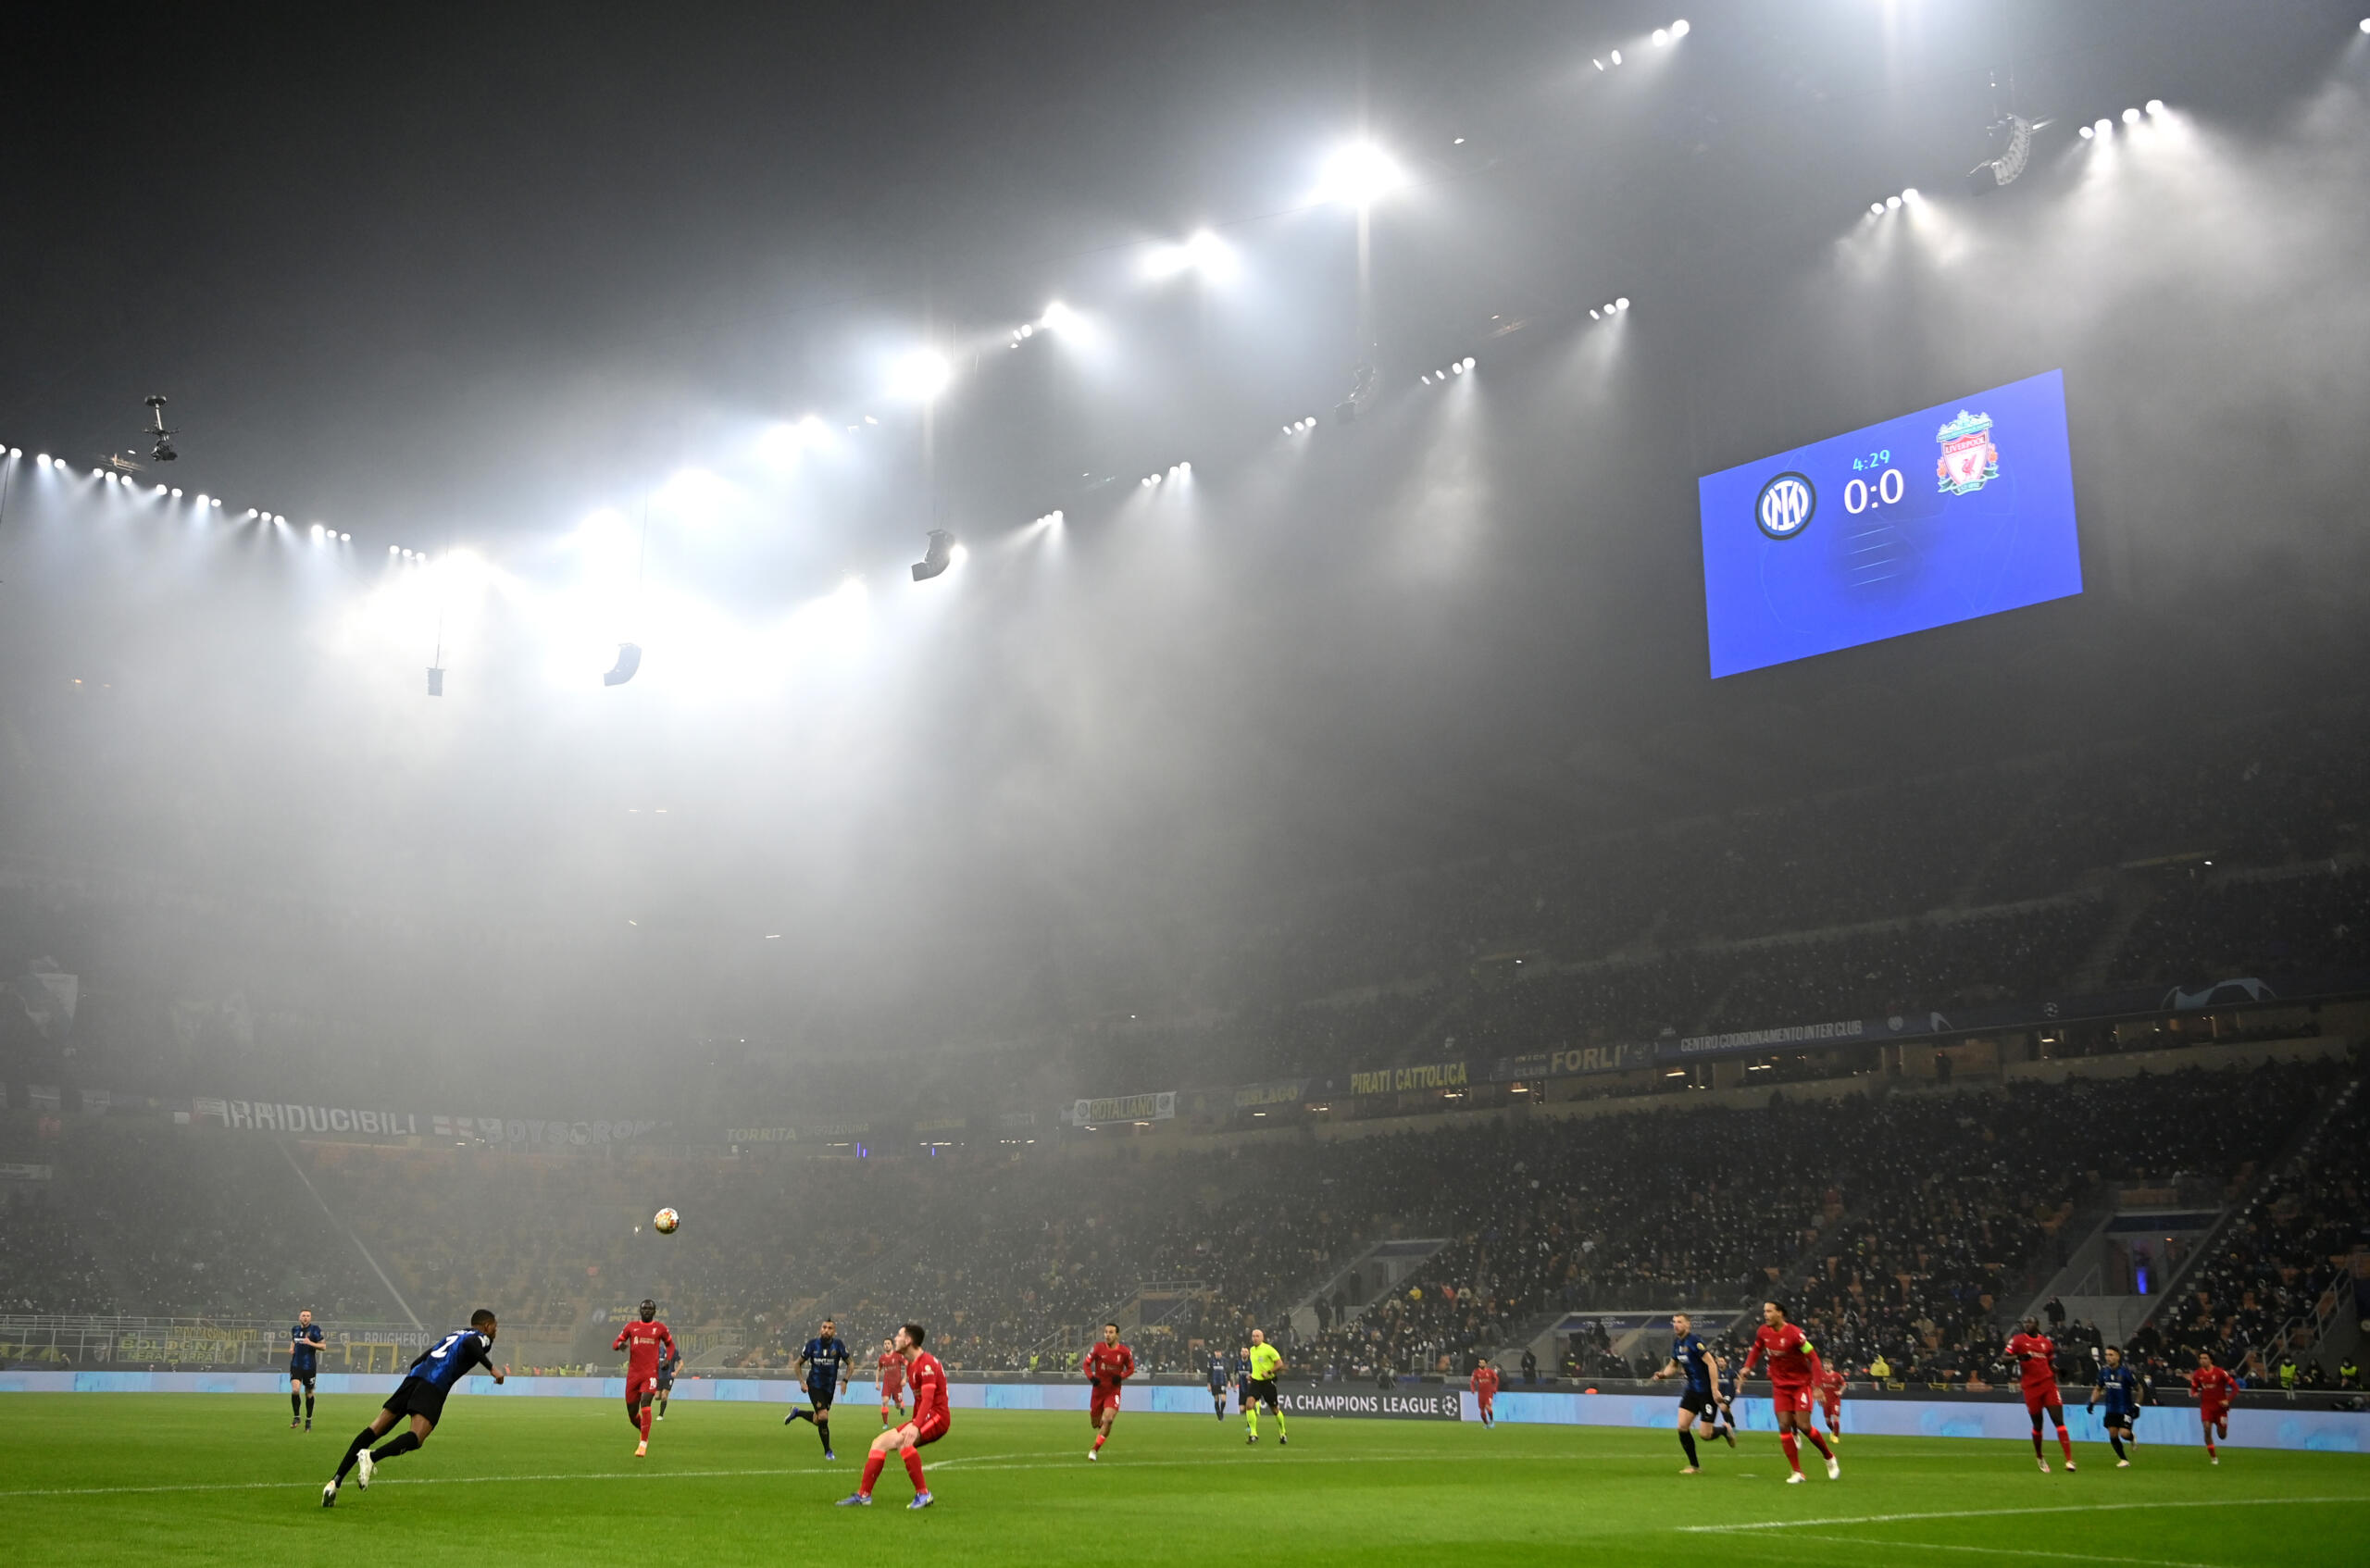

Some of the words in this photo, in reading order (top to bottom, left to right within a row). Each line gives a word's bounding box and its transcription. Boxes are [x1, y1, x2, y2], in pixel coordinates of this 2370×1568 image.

[1946, 435, 1986, 454] LIVERPOOL
[1852, 449, 1890, 471] 4:29
[1844, 468, 1904, 515] 0:0
[1680, 1036, 1718, 1052] CENTRO
[1719, 1027, 1804, 1049] COORDINAMENTO
[1804, 1022, 1835, 1039] INTER
[1834, 1019, 1863, 1036] CLUB
[1351, 1069, 1391, 1095] PIRATI
[1395, 1062, 1467, 1090] CATTOLICA
[1514, 1065, 1547, 1077] CLUB
[1091, 1095, 1155, 1118] ROTALIANO
[726, 1126, 797, 1141] TORRITA
[121, 1339, 221, 1350] BOLOGNA
[364, 1333, 430, 1347] BRUGHERIO
[430, 1335, 459, 1358] 2
[1296, 1394, 1378, 1412] CHAMPIONS
[1383, 1396, 1439, 1413] LEAGUE
